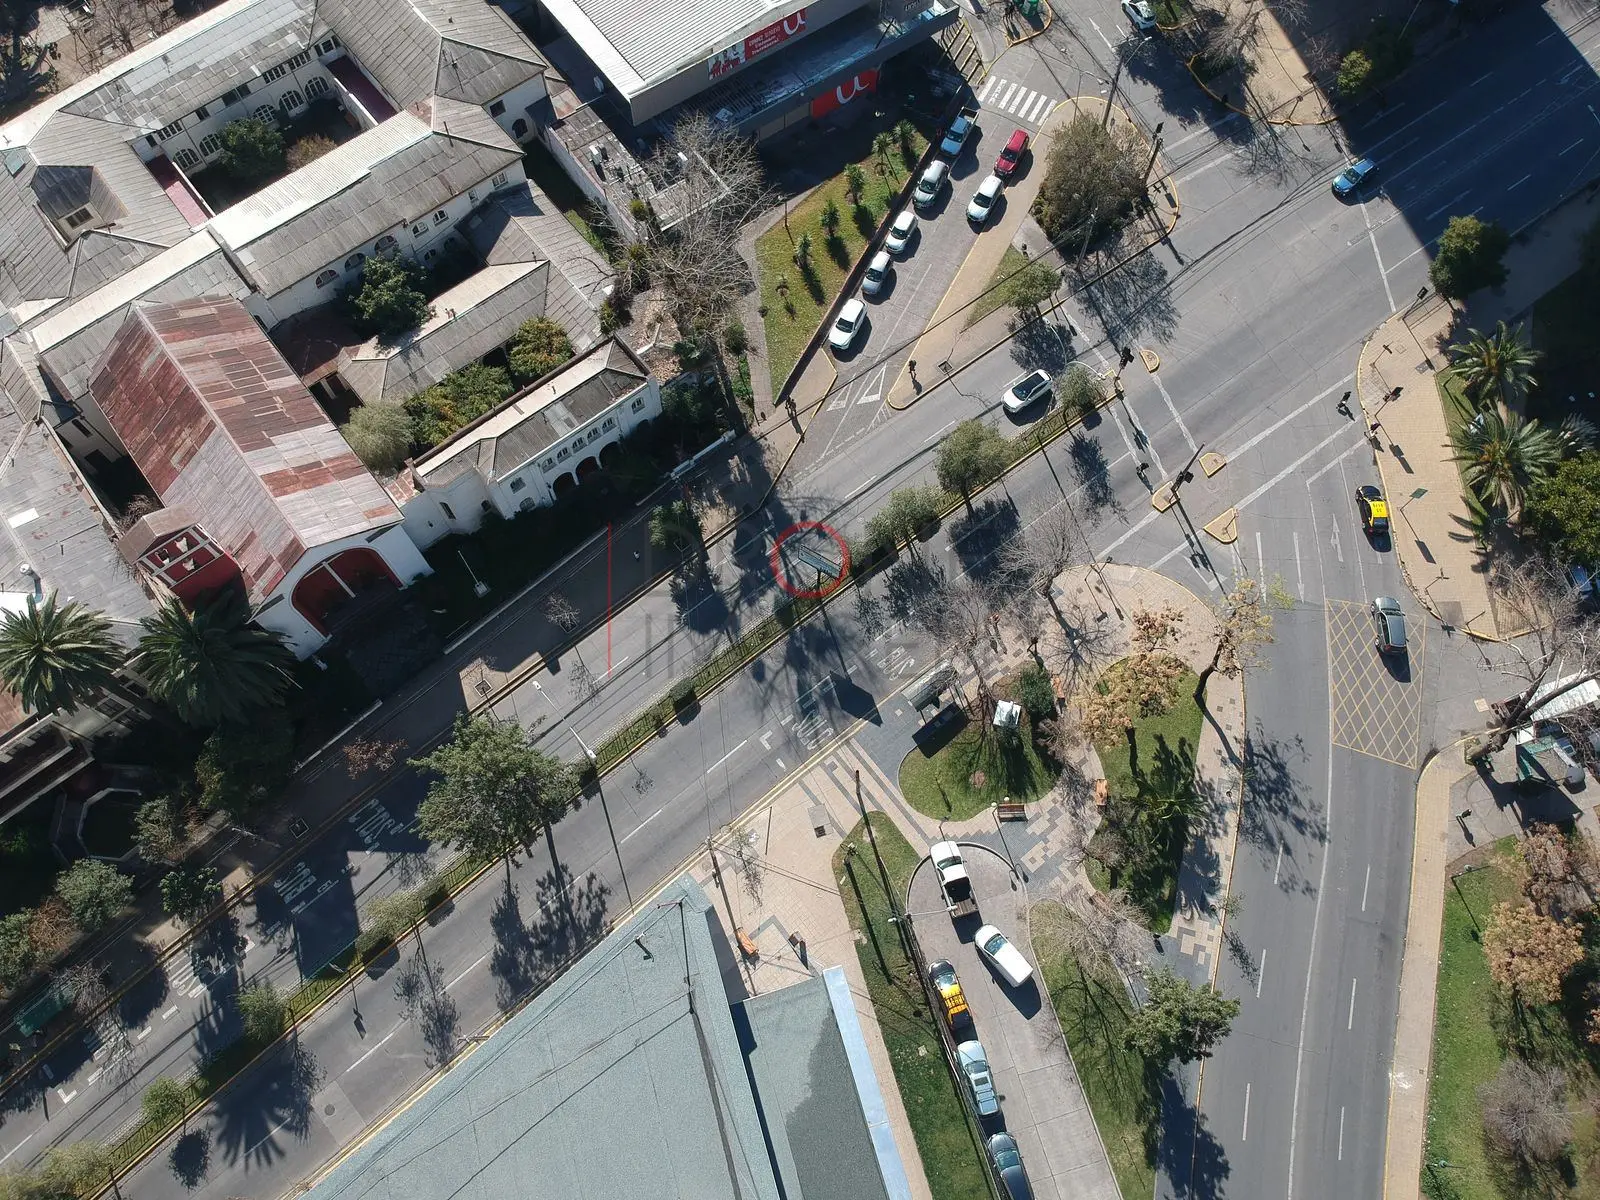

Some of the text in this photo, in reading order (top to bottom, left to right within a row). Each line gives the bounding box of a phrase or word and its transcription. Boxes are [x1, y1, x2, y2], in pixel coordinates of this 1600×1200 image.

[877, 646, 915, 682] BUS
[791, 709, 834, 751] SOLO
[349, 798, 396, 844] SOLO
[273, 862, 317, 905] BUS
